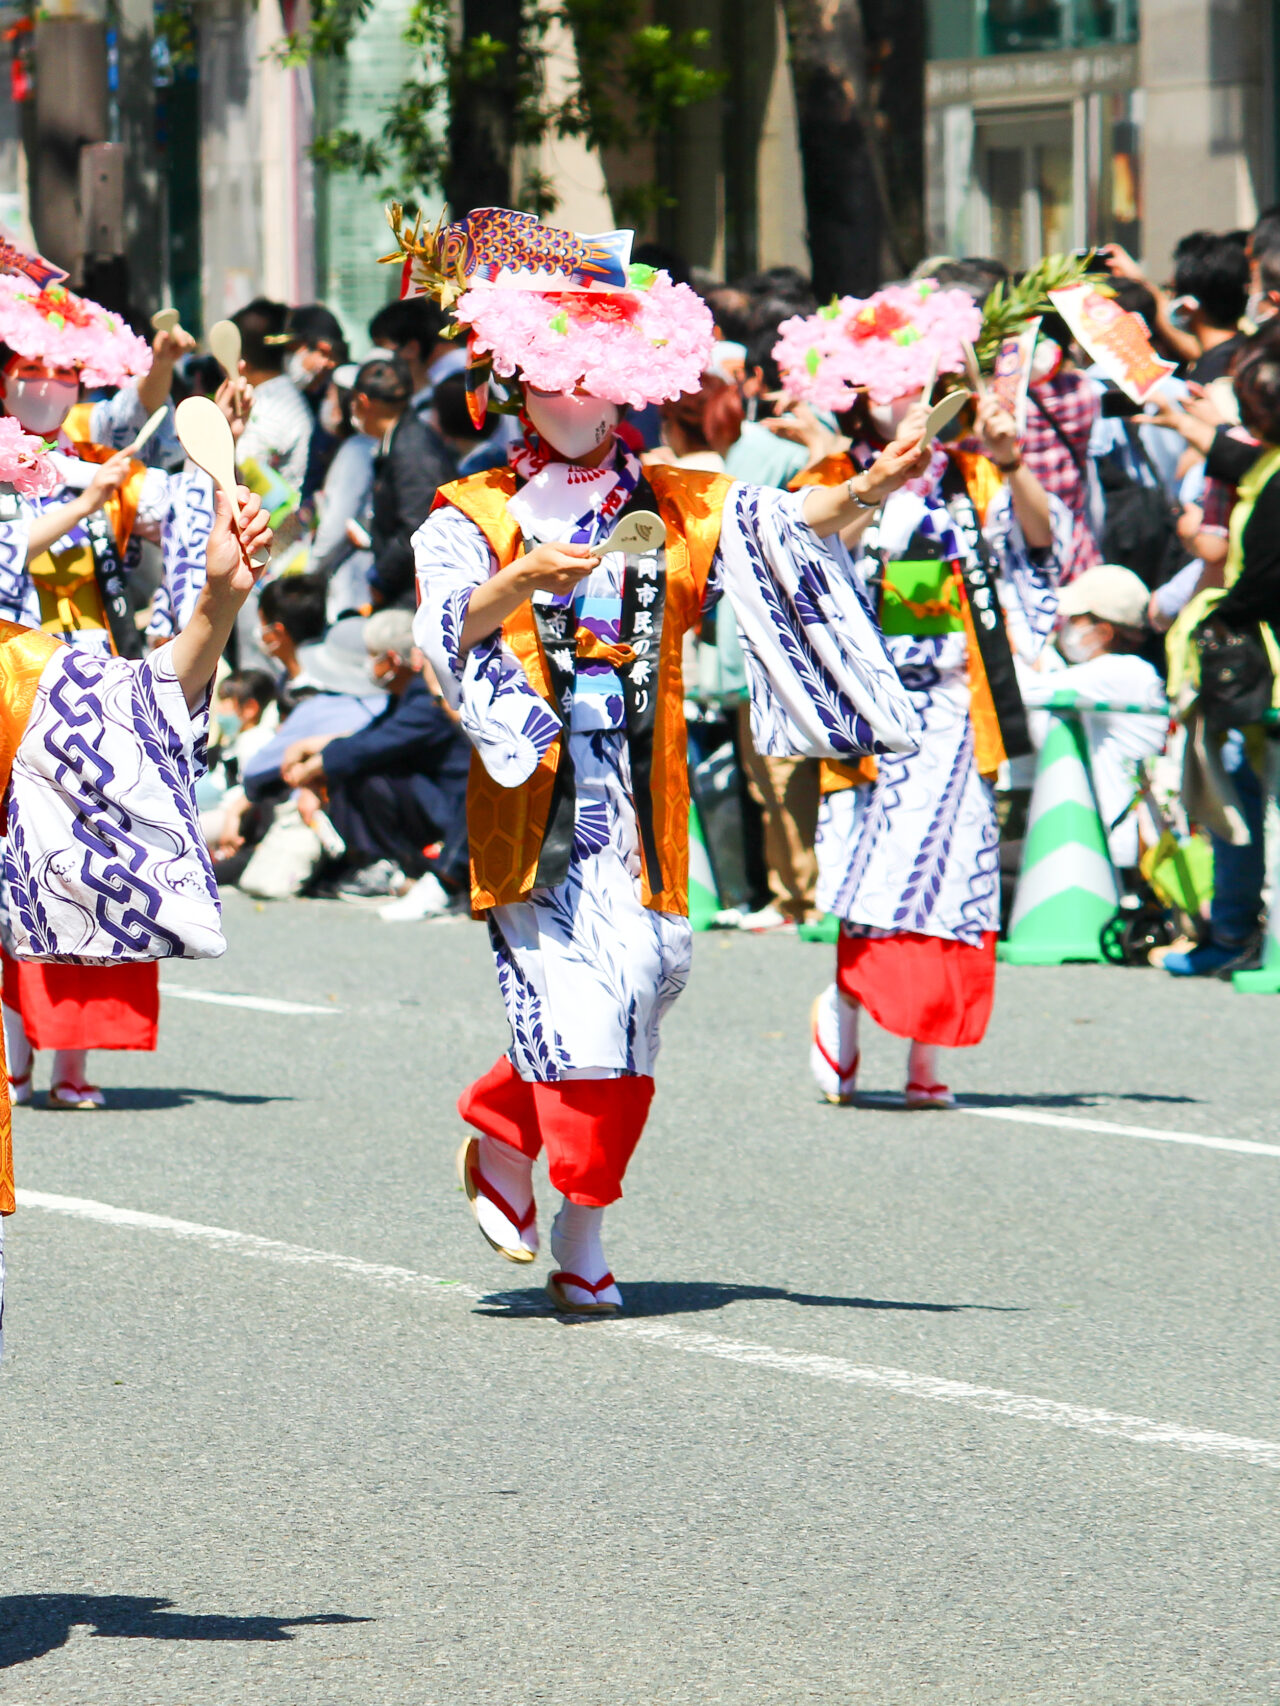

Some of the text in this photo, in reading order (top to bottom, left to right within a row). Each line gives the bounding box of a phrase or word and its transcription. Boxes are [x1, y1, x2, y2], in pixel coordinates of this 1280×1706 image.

[628, 548, 659, 714] 岡市民の祭り
